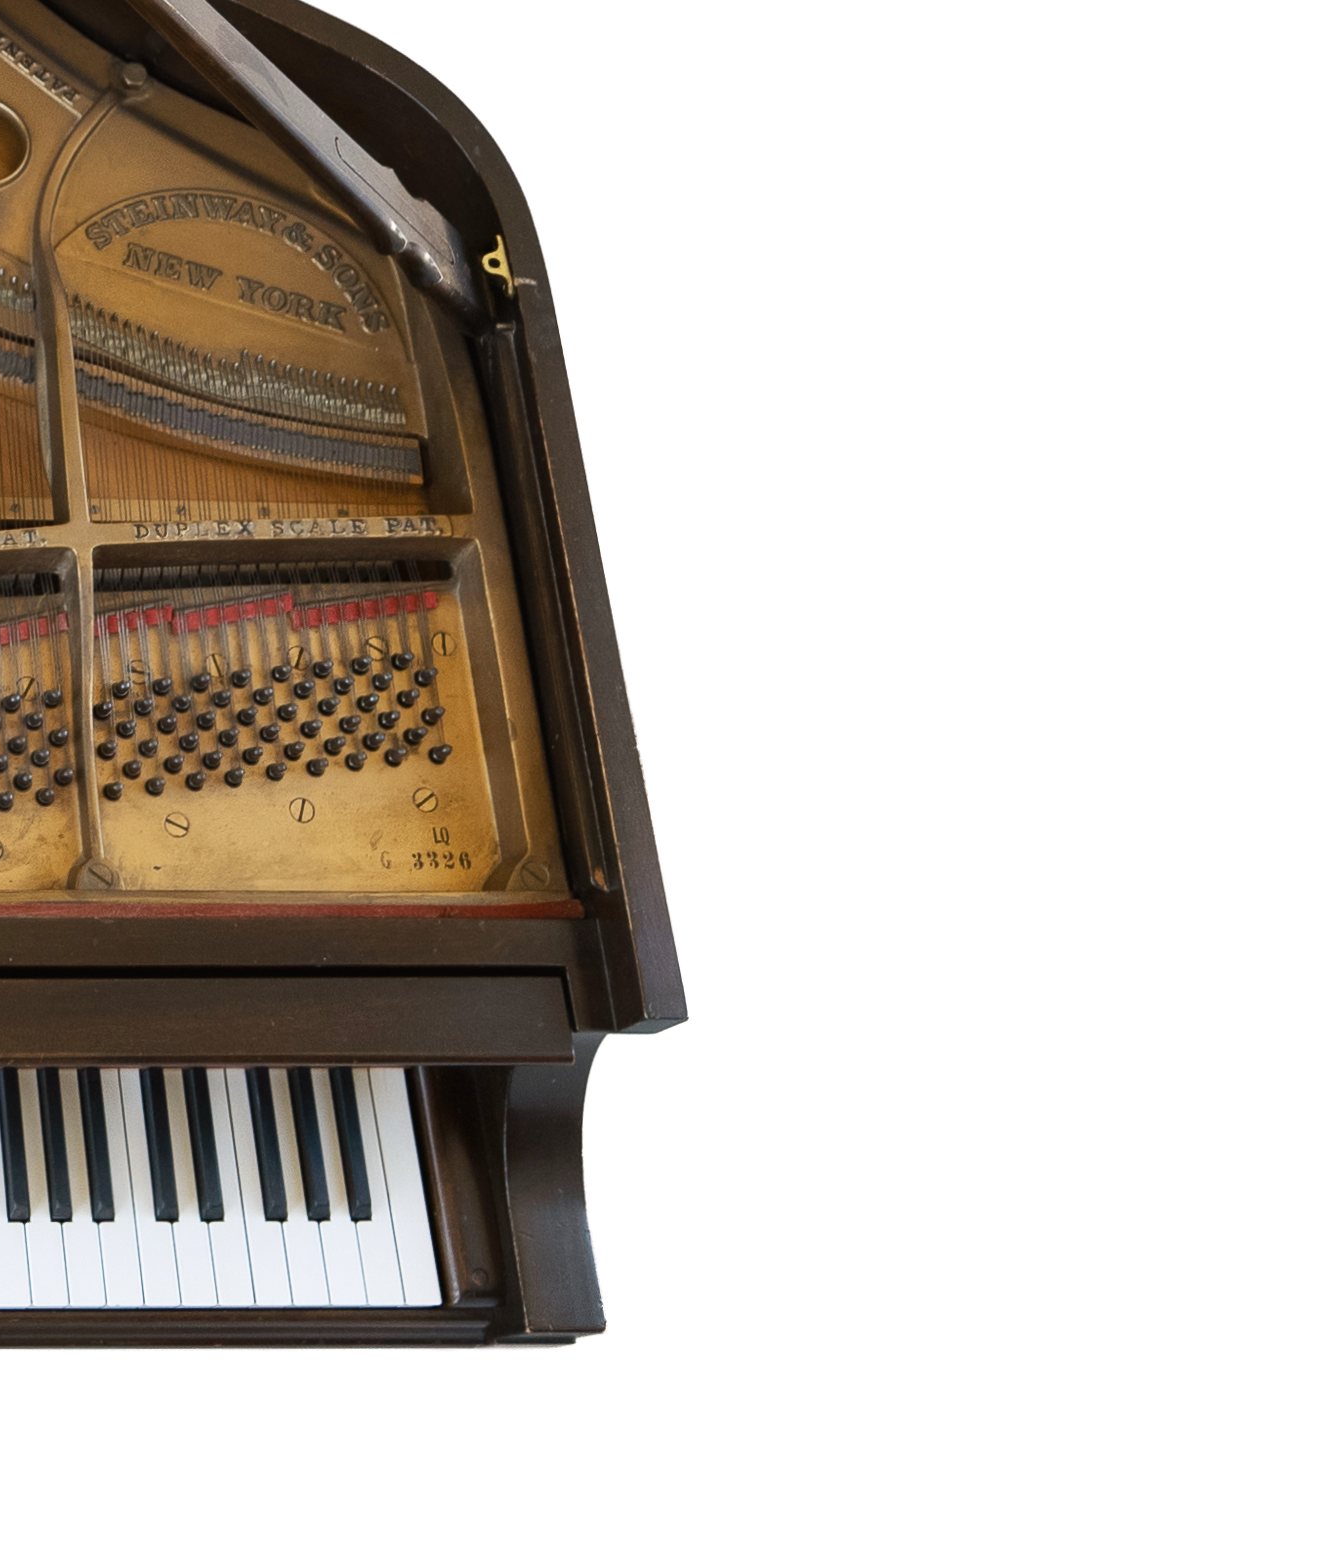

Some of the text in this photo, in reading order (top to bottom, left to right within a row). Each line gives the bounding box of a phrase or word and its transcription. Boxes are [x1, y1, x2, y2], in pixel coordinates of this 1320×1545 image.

[85, 193, 287, 250] STEINWAY
[310, 244, 390, 335] SONS
[122, 242, 347, 332] NEW YORK
[133, 518, 256, 540] DUPLEX
[269, 518, 367, 536] SCALE
[411, 850, 472, 870] 3326
